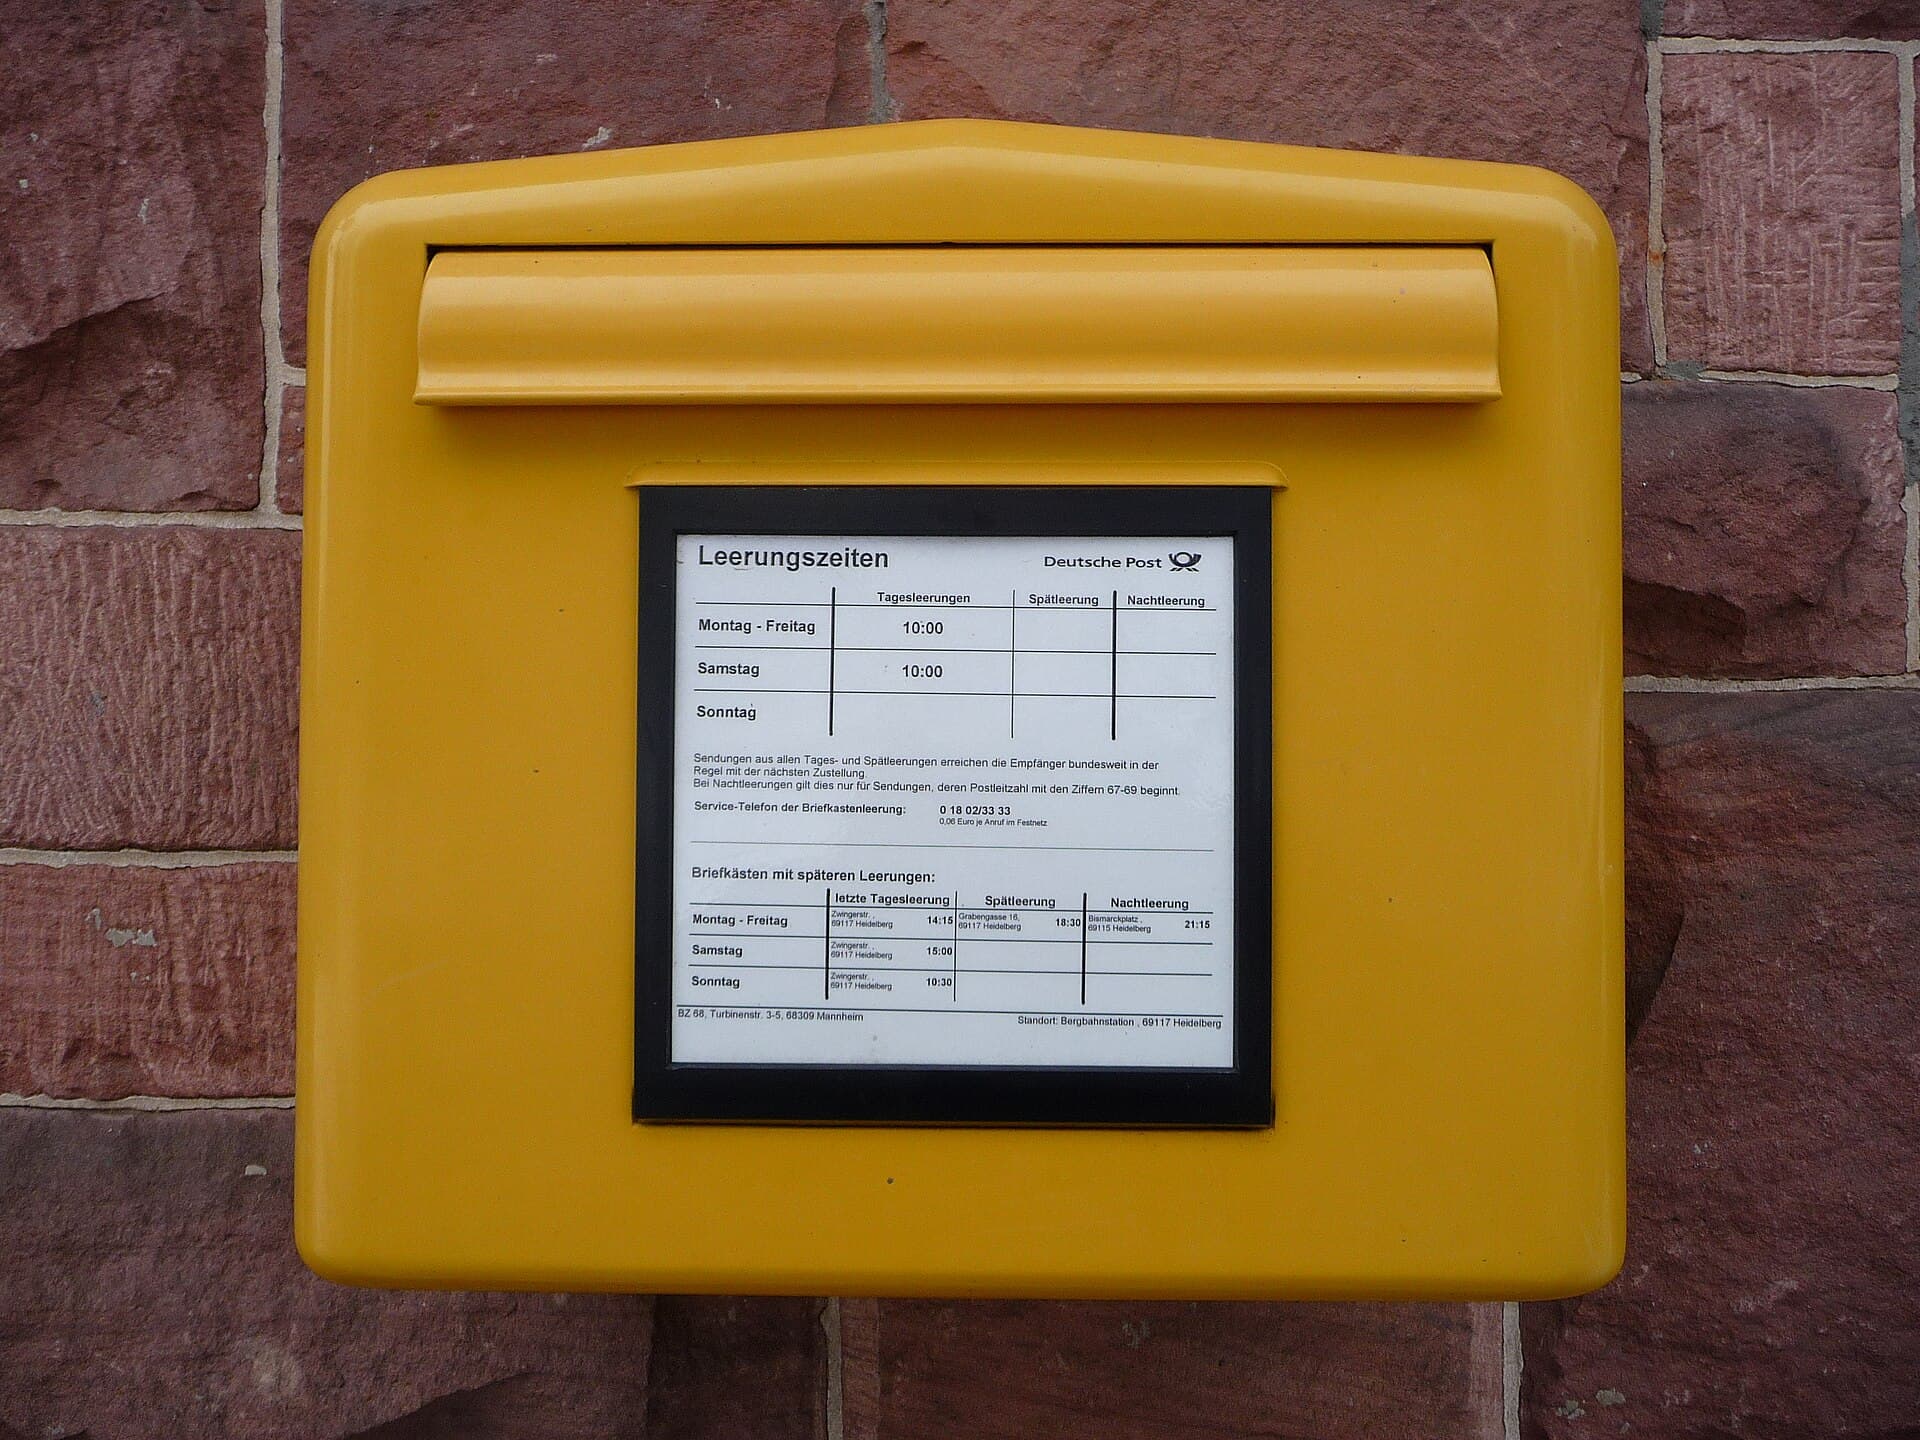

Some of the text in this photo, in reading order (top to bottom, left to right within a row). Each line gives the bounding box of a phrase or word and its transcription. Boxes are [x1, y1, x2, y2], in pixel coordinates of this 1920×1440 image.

[698, 545, 889, 571] Leerungszeiten
[1043, 556, 1162, 569] Deutsche Post
[877, 591, 970, 605] Tagesleerungen
[1029, 593, 1099, 607] Spätleerung
[1127, 595, 1205, 608] Nachtleerung
[698, 619, 752, 634] Montag
[766, 619, 816, 635] Freitag
[903, 621, 944, 635] 10:00
[697, 662, 760, 677] Samstag
[902, 664, 943, 679] 10:00
[696, 705, 757, 720] Sonntag
[693, 754, 1159, 771] Sendungen aus allen Tages- und Spätleerungen erreichen die Empfänger bundesweit in der
[693, 766, 723, 777] Regel
[726, 767, 741, 776] mit
[744, 767, 761, 776] der
[764, 767, 810, 777] nächsten
[693, 779, 709, 788] Bei
[713, 779, 793, 791] Nachtleerungen
[796, 780, 811, 791] gilt
[814, 780, 834, 790] dies
[837, 783, 853, 791] nur
[856, 781, 870, 791] für
[937, 783, 967, 793] deren
[970, 783, 1029, 793] Postleitzahl
[1031, 784, 1047, 794] mit
[1049, 784, 1069, 794] den
[1071, 784, 1105, 795] Ziffern
[1107, 785, 1137, 795] 67-69
[694, 801, 906, 816] Service-Telefon der Briefkastenleerung:
[939, 805, 1011, 816] 0 18 02/33 33
[957, 818, 974, 826] Euro
[976, 819, 983, 828] je
[1017, 819, 1048, 827] Festnetz
[691, 867, 935, 885] Briefkästen mit späteren Leerungen:
[835, 893, 950, 906] letzte Tagesleerung
[985, 895, 1056, 909] Spätleerung
[1111, 897, 1189, 910] Nachtleerung
[692, 915, 736, 927] Montag
[747, 915, 788, 928] Freitag
[927, 916, 953, 925] 14:15
[958, 913, 1007, 922] Grabengasse
[1056, 918, 1081, 927] 18:30
[1088, 915, 1139, 924] Bismarckplatz
[855, 920, 893, 930] Heidelberg
[958, 922, 1022, 932] 69117 Heidelberg
[1088, 924, 1151, 934] 69115 Heidelberg
[1184, 920, 1211, 929] 21:15
[692, 945, 743, 958] Samstag
[830, 951, 893, 960] 69117 Heidelberg
[926, 947, 953, 956] 15:00
[691, 976, 740, 989] Sonntag
[830, 982, 892, 991] 69117 Heidelberg
[926, 978, 952, 987] 10:30
[678, 1009, 691, 1018] BZ
[786, 1011, 815, 1020] 68309
[817, 1011, 864, 1022] Mannheim
[1018, 1016, 1058, 1026] Standort:
[1060, 1017, 1135, 1028] Bergbahnstation
[1142, 1018, 1171, 1027] 69117
[1173, 1019, 1222, 1029] Heidelberg
